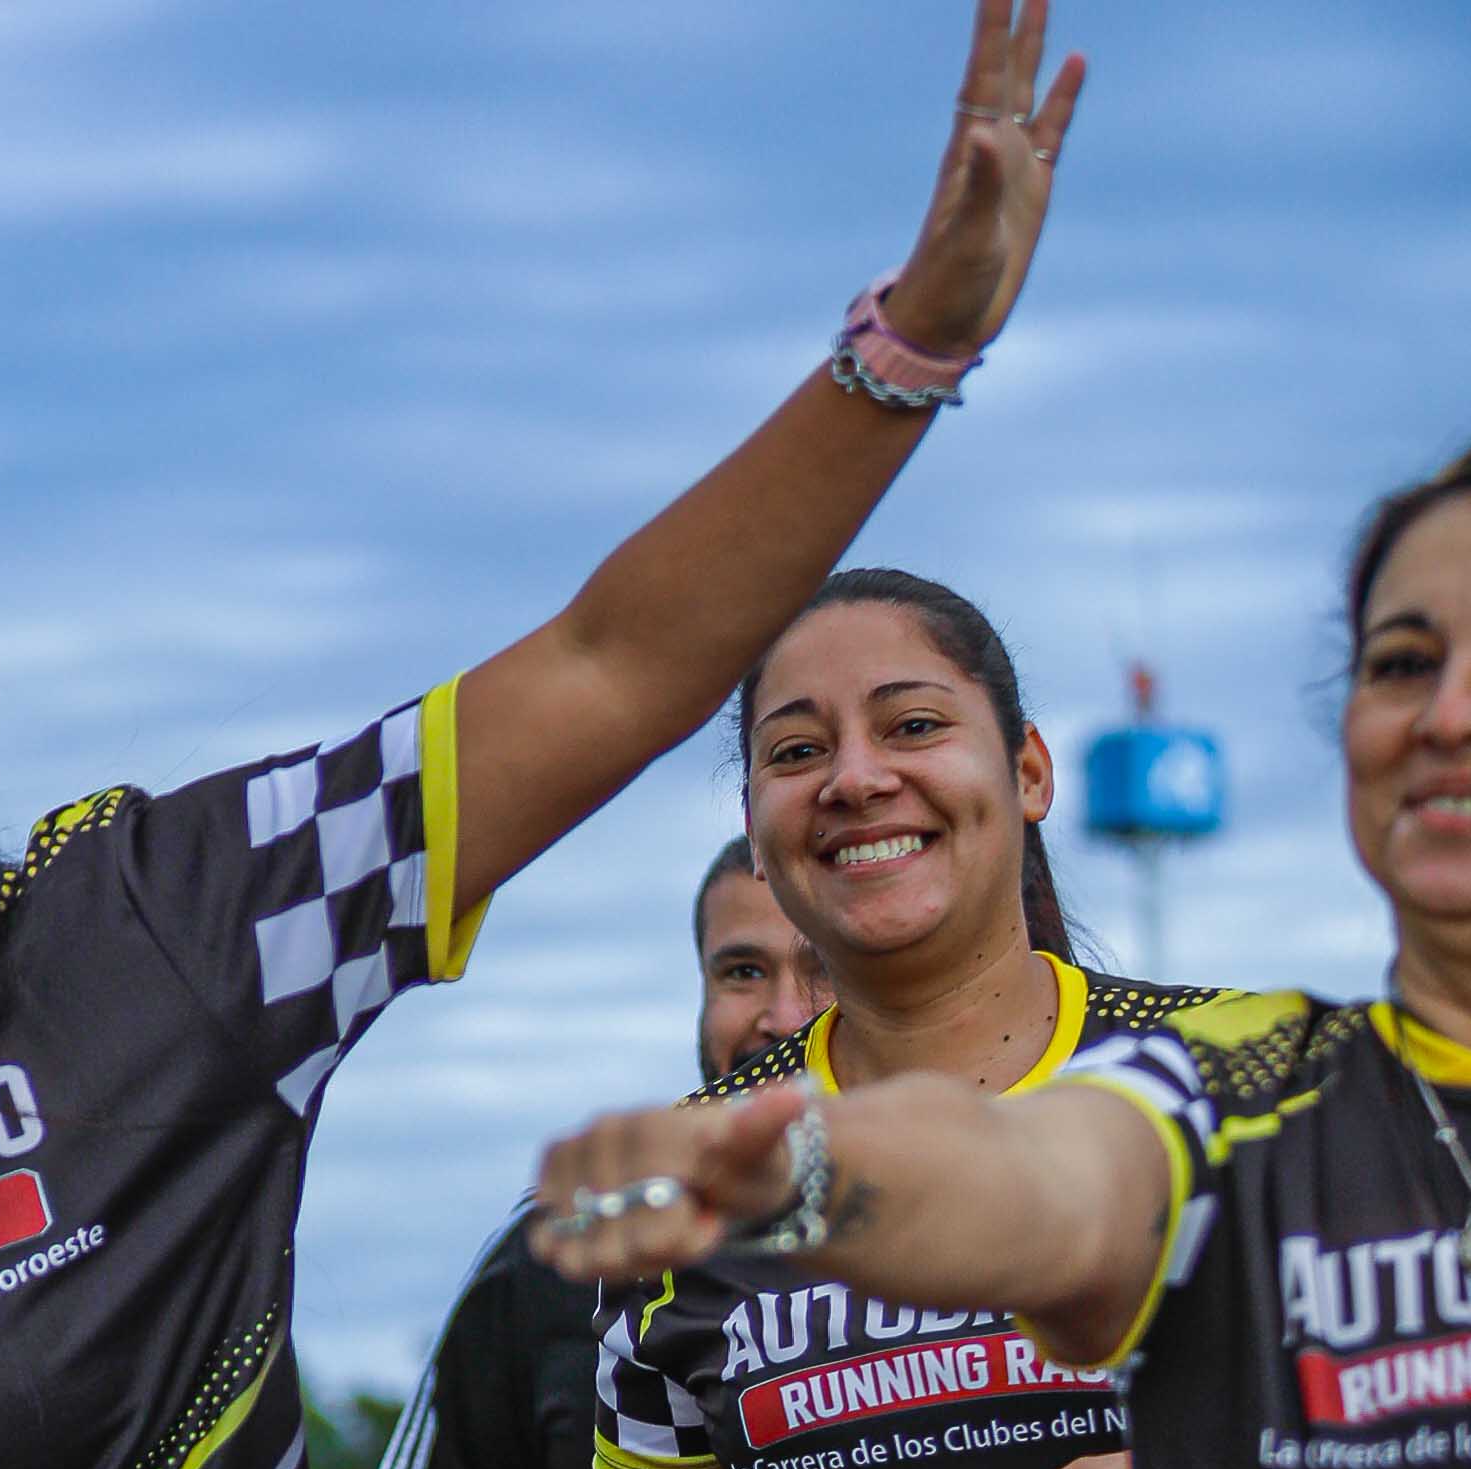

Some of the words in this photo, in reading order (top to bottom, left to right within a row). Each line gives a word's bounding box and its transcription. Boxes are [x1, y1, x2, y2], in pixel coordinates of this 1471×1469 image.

[778, 1343, 991, 1430] RUNNING
[894, 1431, 937, 1462] los
[944, 1416, 1044, 1453] Clubes
[1050, 1407, 1098, 1440] del
[1405, 1424, 1450, 1463] de
